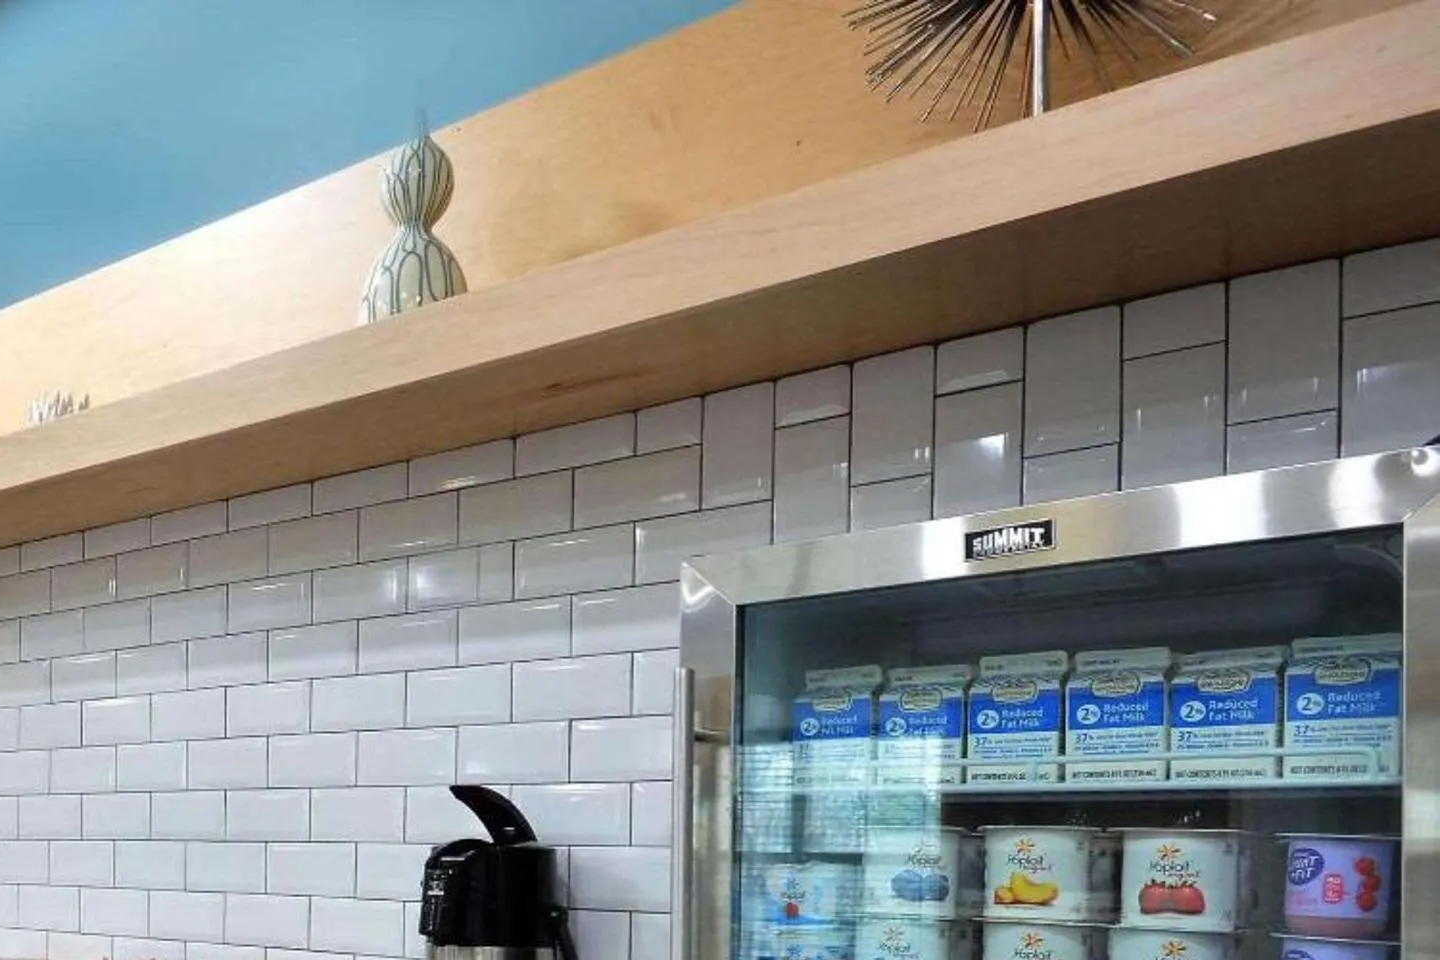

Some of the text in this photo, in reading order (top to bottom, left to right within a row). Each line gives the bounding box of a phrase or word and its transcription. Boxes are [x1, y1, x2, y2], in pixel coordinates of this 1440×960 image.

[972, 527, 1045, 554] SUMMIT
[1327, 691, 1382, 702] Reduced
[1103, 701, 1149, 713] Reduced
[1209, 699, 1259, 710] Reduced
[1327, 702, 1375, 714] Fat Milk
[1001, 706, 1044, 718] Reduced
[1103, 712, 1145, 723] Fat Milk
[1209, 709, 1255, 721] Fat Milk
[1001, 718, 1040, 729] Fat Milk
[1007, 853, 1044, 869] Yoplait
[1150, 860, 1190, 876] Yoplait
